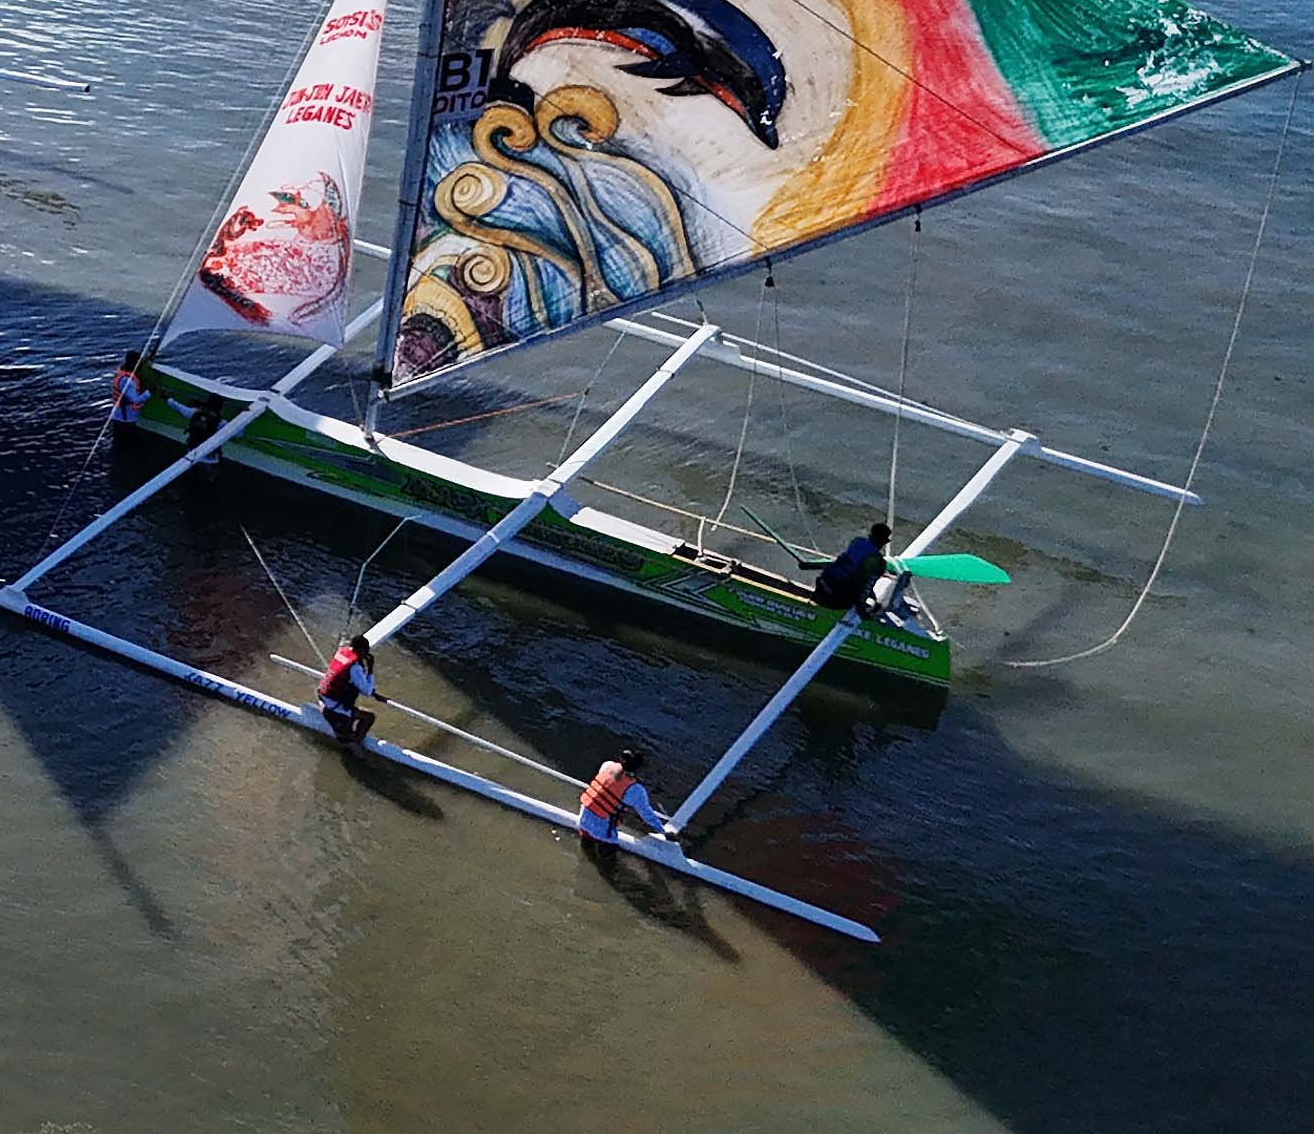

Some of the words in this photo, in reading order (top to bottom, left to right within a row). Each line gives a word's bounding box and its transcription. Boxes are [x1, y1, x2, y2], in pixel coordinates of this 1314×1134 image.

[438, 48, 495, 93] B1
[433, 89, 487, 115] DITO
[285, 105, 356, 131] LEGANES
[234, 690, 291, 718] YELLOW
